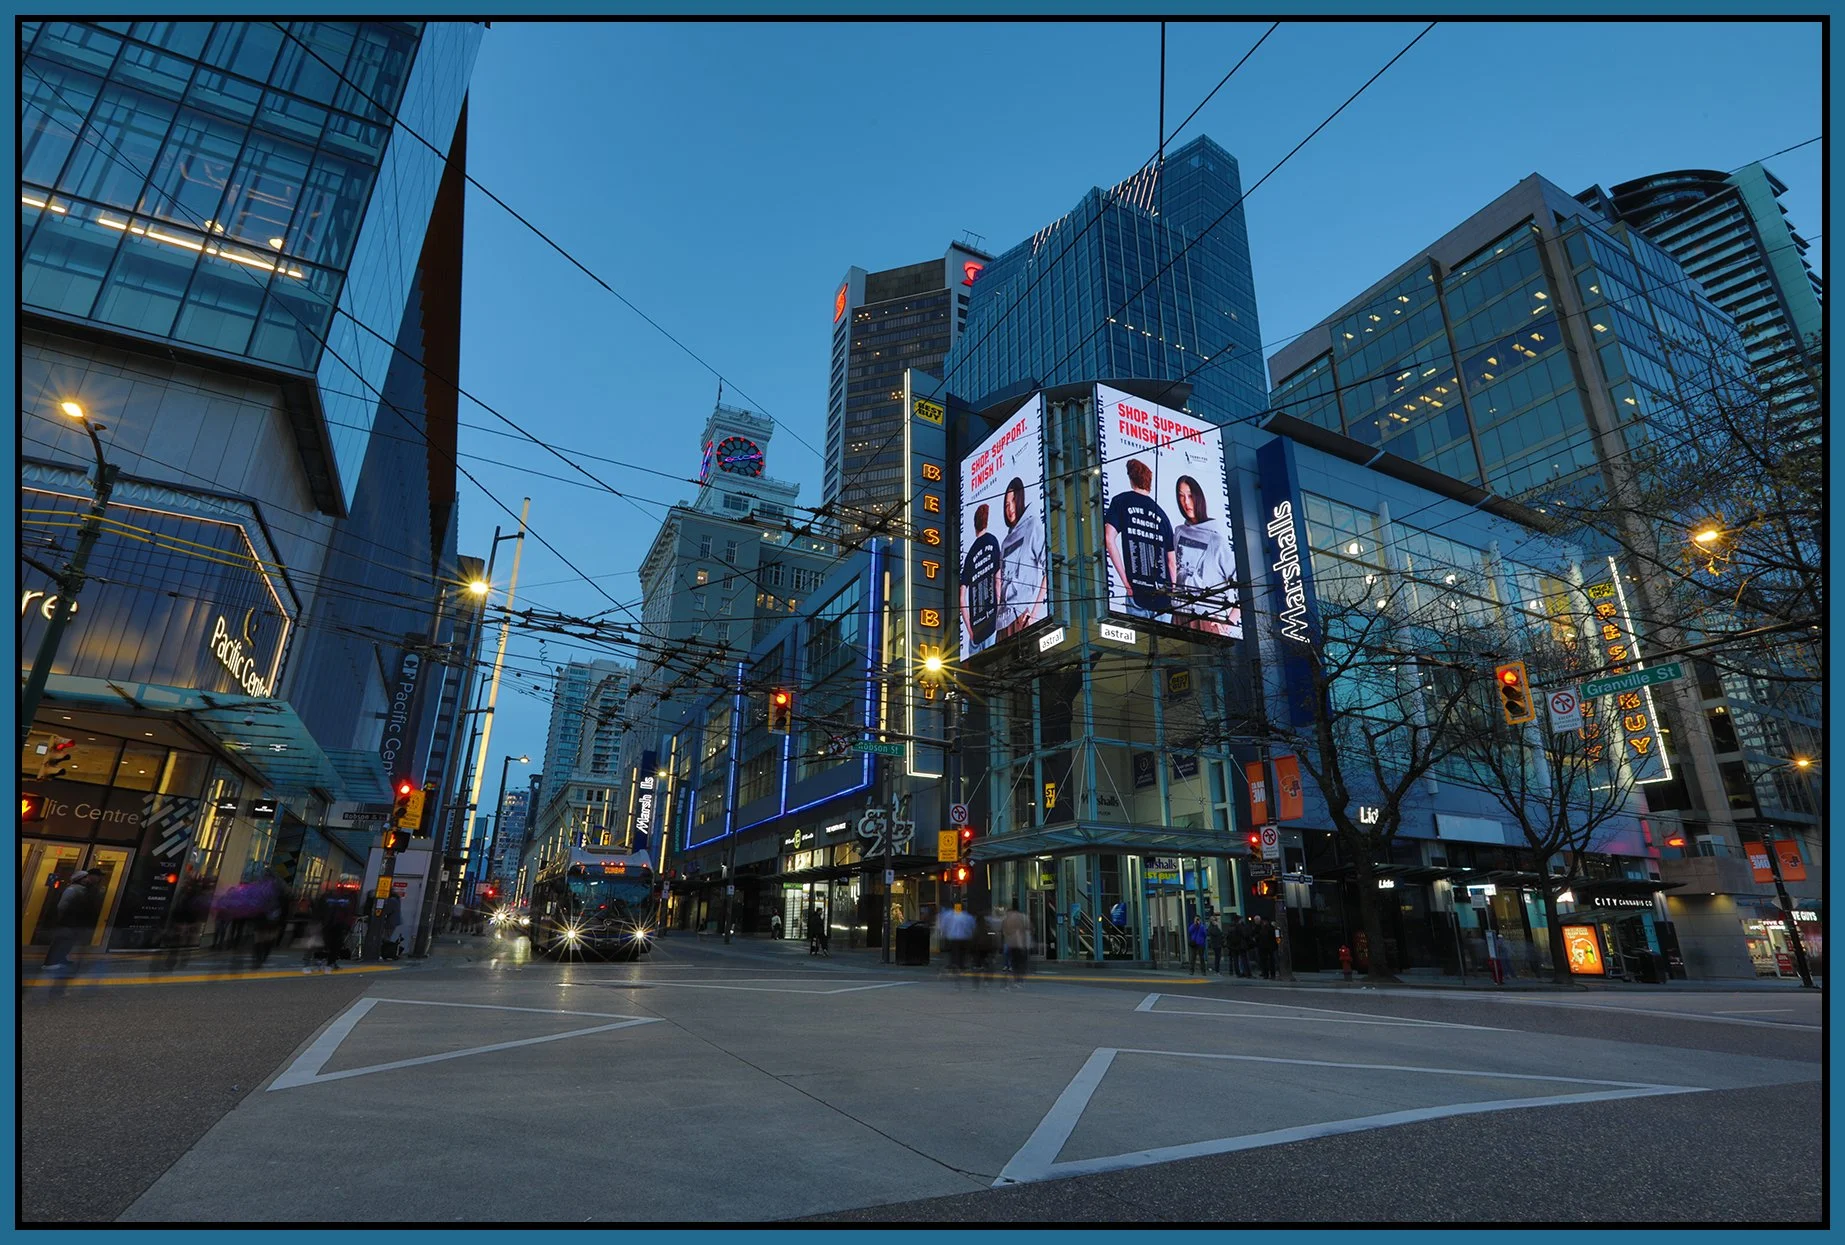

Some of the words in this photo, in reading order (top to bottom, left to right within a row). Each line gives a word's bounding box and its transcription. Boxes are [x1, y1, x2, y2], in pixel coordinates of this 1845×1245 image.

[918, 401, 943, 416] BEST
[918, 409, 940, 421] BUY
[1117, 403, 1149, 426] SHOP.
[1152, 415, 1206, 446] SUPPORT.
[1119, 419, 1158, 445] FINISH
[1161, 434, 1175, 451] IT.
[971, 450, 990, 476] SHOP.
[991, 417, 1028, 458] SUPPORT.
[971, 465, 994, 492] FINISH
[996, 455, 1006, 471] IT.
[922, 462, 942, 579] BEST
[1127, 506, 1144, 515] GIVE
[1266, 500, 1310, 643] Marshalls
[1042, 630, 1062, 649] astral
[1104, 627, 1133, 640] astral
[210, 614, 245, 680] Pacific
[1586, 673, 1650, 696] Granville
[1656, 666, 1675, 680] St
[1595, 603, 1631, 673] BES
[1618, 692, 1651, 755] BUY
[389, 681, 414, 734] Pacific
[635, 776, 654, 835] Marshlls
[1081, 792, 1120, 808] Mshalls
[74, 802, 139, 825] Centre
[1359, 805, 1379, 825] Lid
[861, 818, 913, 836] CRPE
[1144, 857, 1177, 870] arshalls
[1594, 896, 1618, 907] CITY
[1618, 898, 1644, 907] CANNABIS
[1645, 899, 1654, 907] CO
[1800, 911, 1818, 921] GUYS
